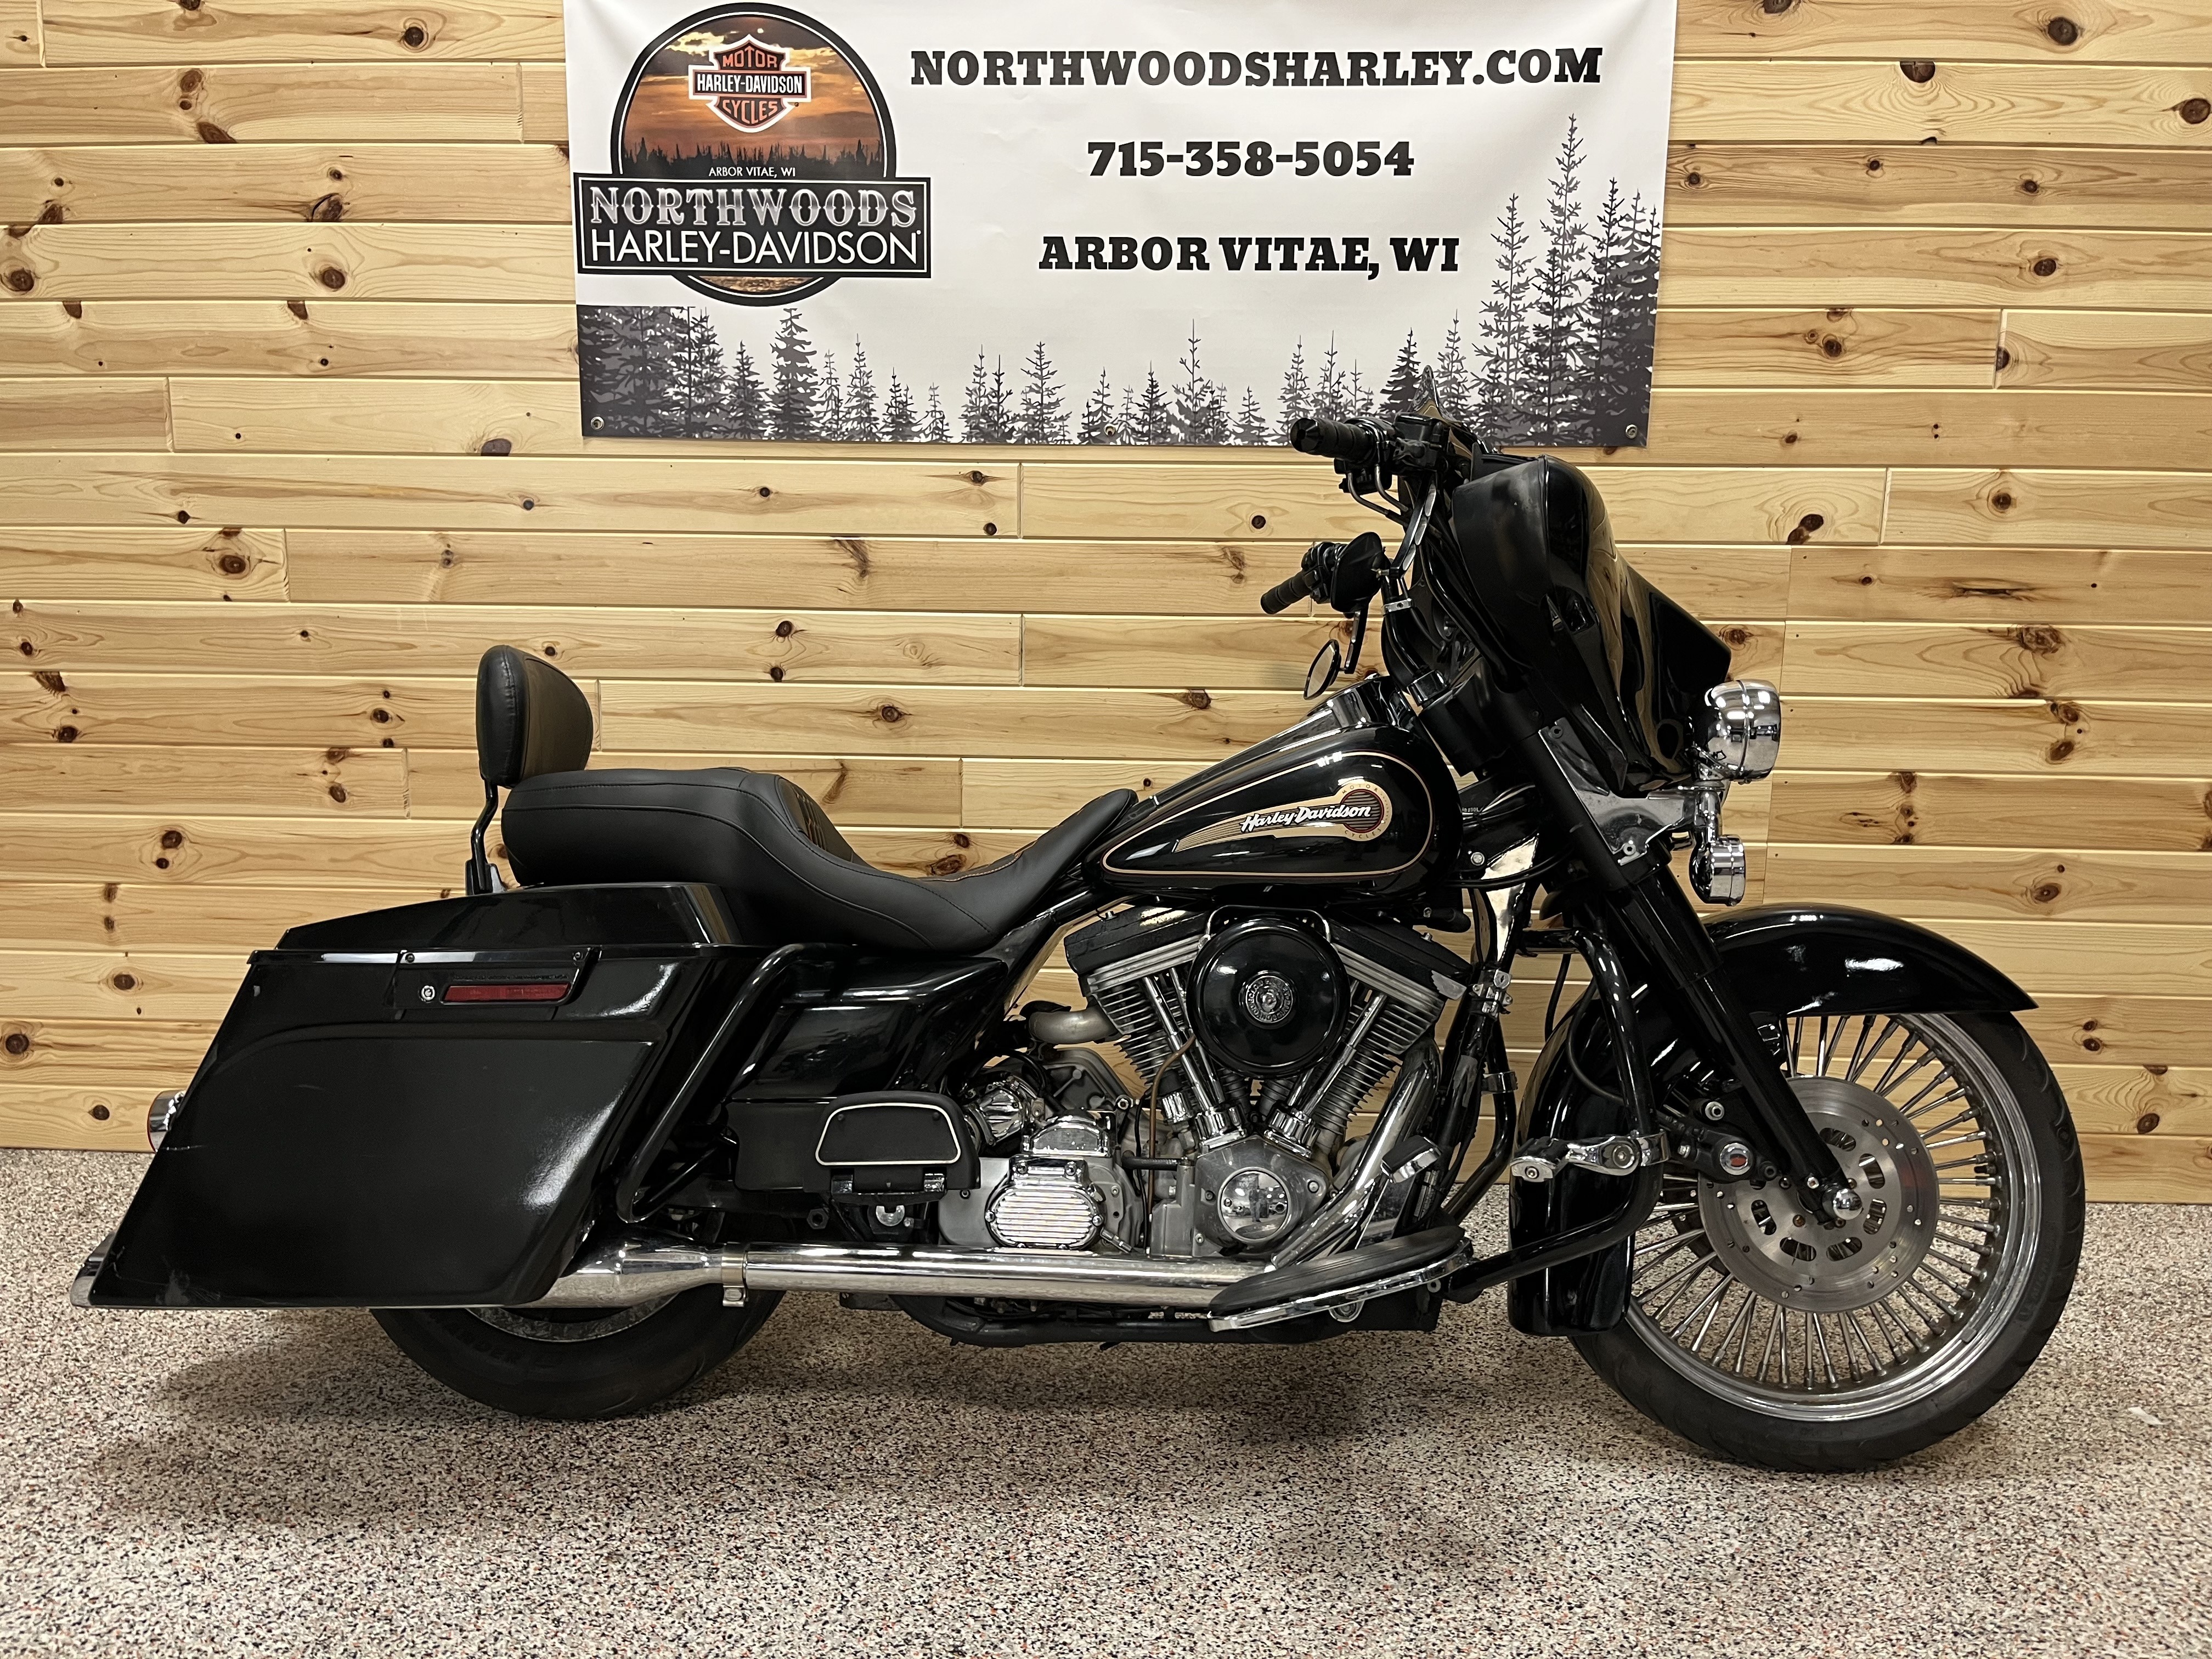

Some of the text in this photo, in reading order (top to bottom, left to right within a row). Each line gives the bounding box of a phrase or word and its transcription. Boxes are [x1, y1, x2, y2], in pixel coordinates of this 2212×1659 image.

[723, 46, 777, 67] MOTOR
[911, 48, 1603, 87] NORTHWOODSHARLEY.COM
[697, 74, 803, 93] HARLEY-DAVIDSON
[723, 99, 778, 124] CYCLES
[1088, 141, 1414, 177] 715-358-5054
[709, 167, 795, 178] ARBOR VITAE, WI
[590, 187, 917, 228] NORTHWOODS
[591, 229, 917, 264] HARLEY-DAVIDSON
[1039, 236, 1459, 280] ARBOR VITAE, WI
[1341, 783, 1378, 794] MOTOR
[1344, 827, 1382, 839] CYCLES
